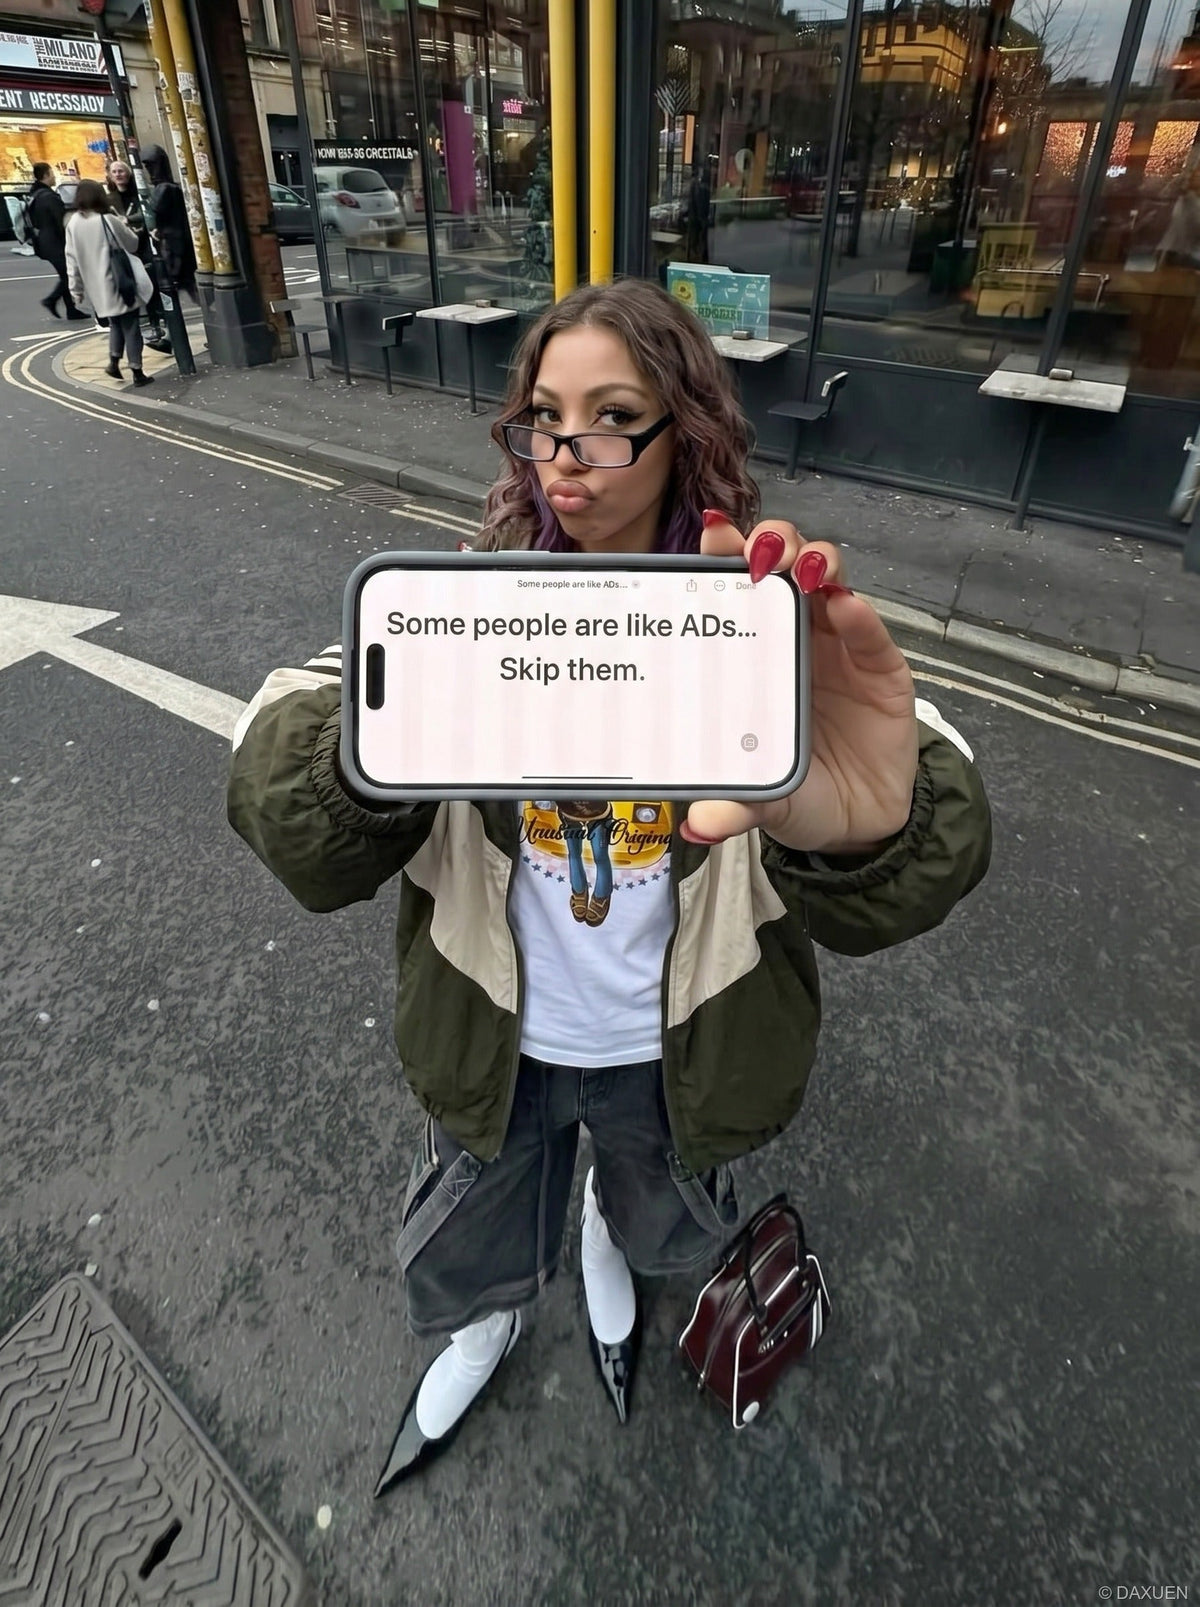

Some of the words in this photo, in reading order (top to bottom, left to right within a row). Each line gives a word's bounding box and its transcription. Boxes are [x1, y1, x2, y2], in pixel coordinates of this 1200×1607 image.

[517, 580, 540, 588] Some
[542, 580, 570, 589] people
[587, 580, 601, 588] like
[735, 581, 757, 590] Done
[387, 611, 466, 636] Some
[473, 612, 567, 642] people
[575, 618, 619, 637] are
[627, 612, 673, 637] like
[680, 613, 757, 638] ADs...
[500, 656, 560, 686] Skip
[566, 657, 645, 681] them.
